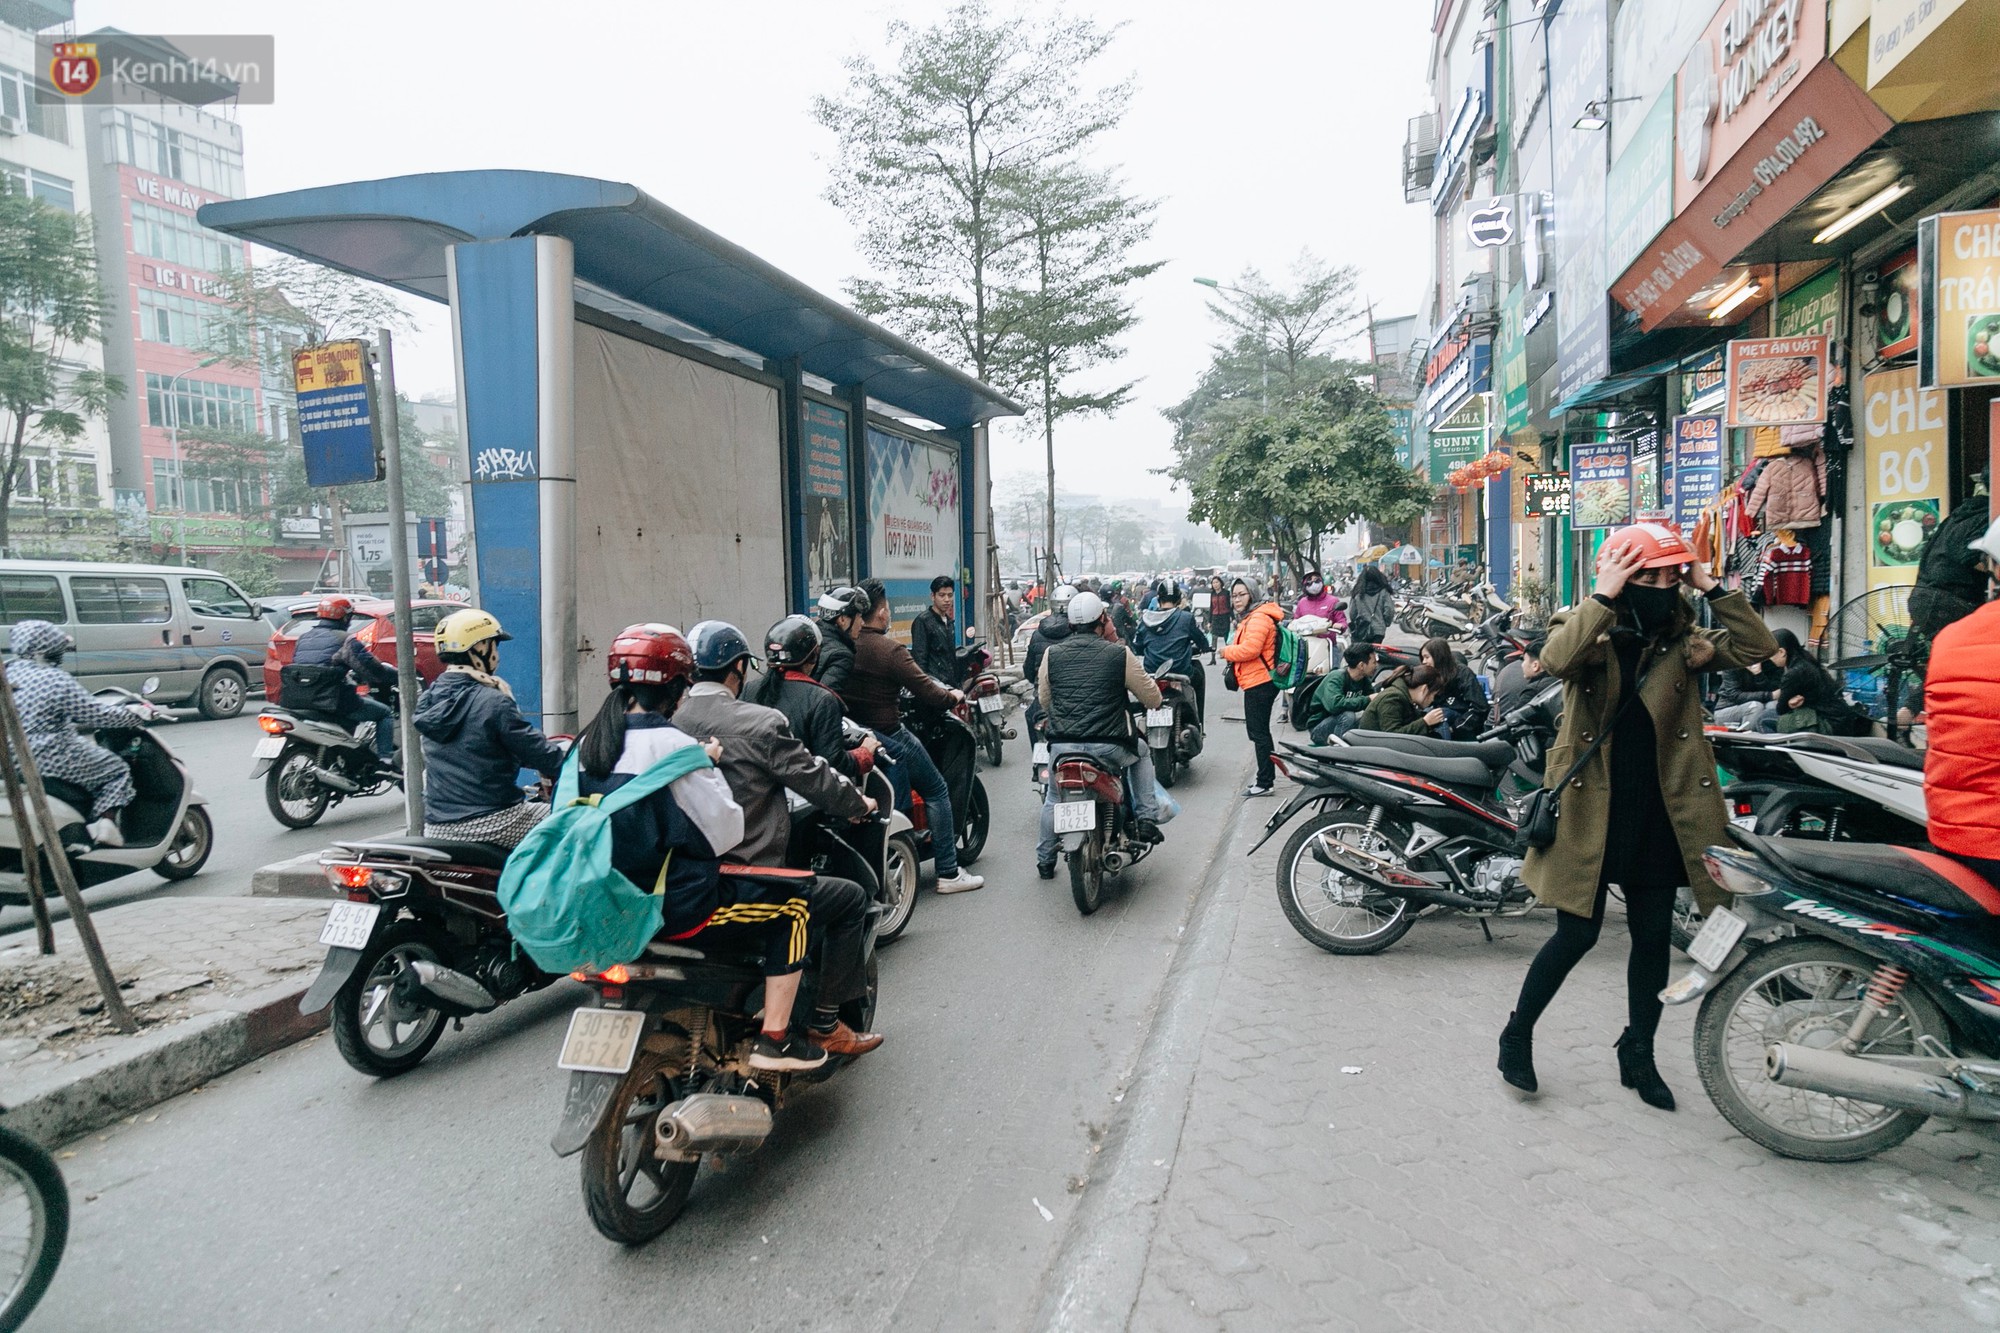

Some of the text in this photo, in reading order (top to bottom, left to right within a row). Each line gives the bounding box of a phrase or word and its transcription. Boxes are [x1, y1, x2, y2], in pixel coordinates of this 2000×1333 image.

[1721, 0, 1800, 122] MONKEY
[136, 176, 199, 211] VÉ MÁY
[1739, 343, 1768, 357] MẸT
[1771, 340, 1789, 353] ĂN
[1680, 418, 1717, 440] 492
[1433, 435, 1480, 448] SUNNY
[1575, 454, 1628, 469] 492
[1879, 441, 1932, 496] BƠ
[1579, 469, 1597, 479] XÃ
[888, 531, 934, 558] 097 869 1111
[1060, 803, 1089, 817] 36-L7
[1060, 816, 1089, 830] 0425
[334, 905, 371, 925] 29-G1
[322, 923, 367, 945] 713.59
[579, 1013, 633, 1040] 30-F6
